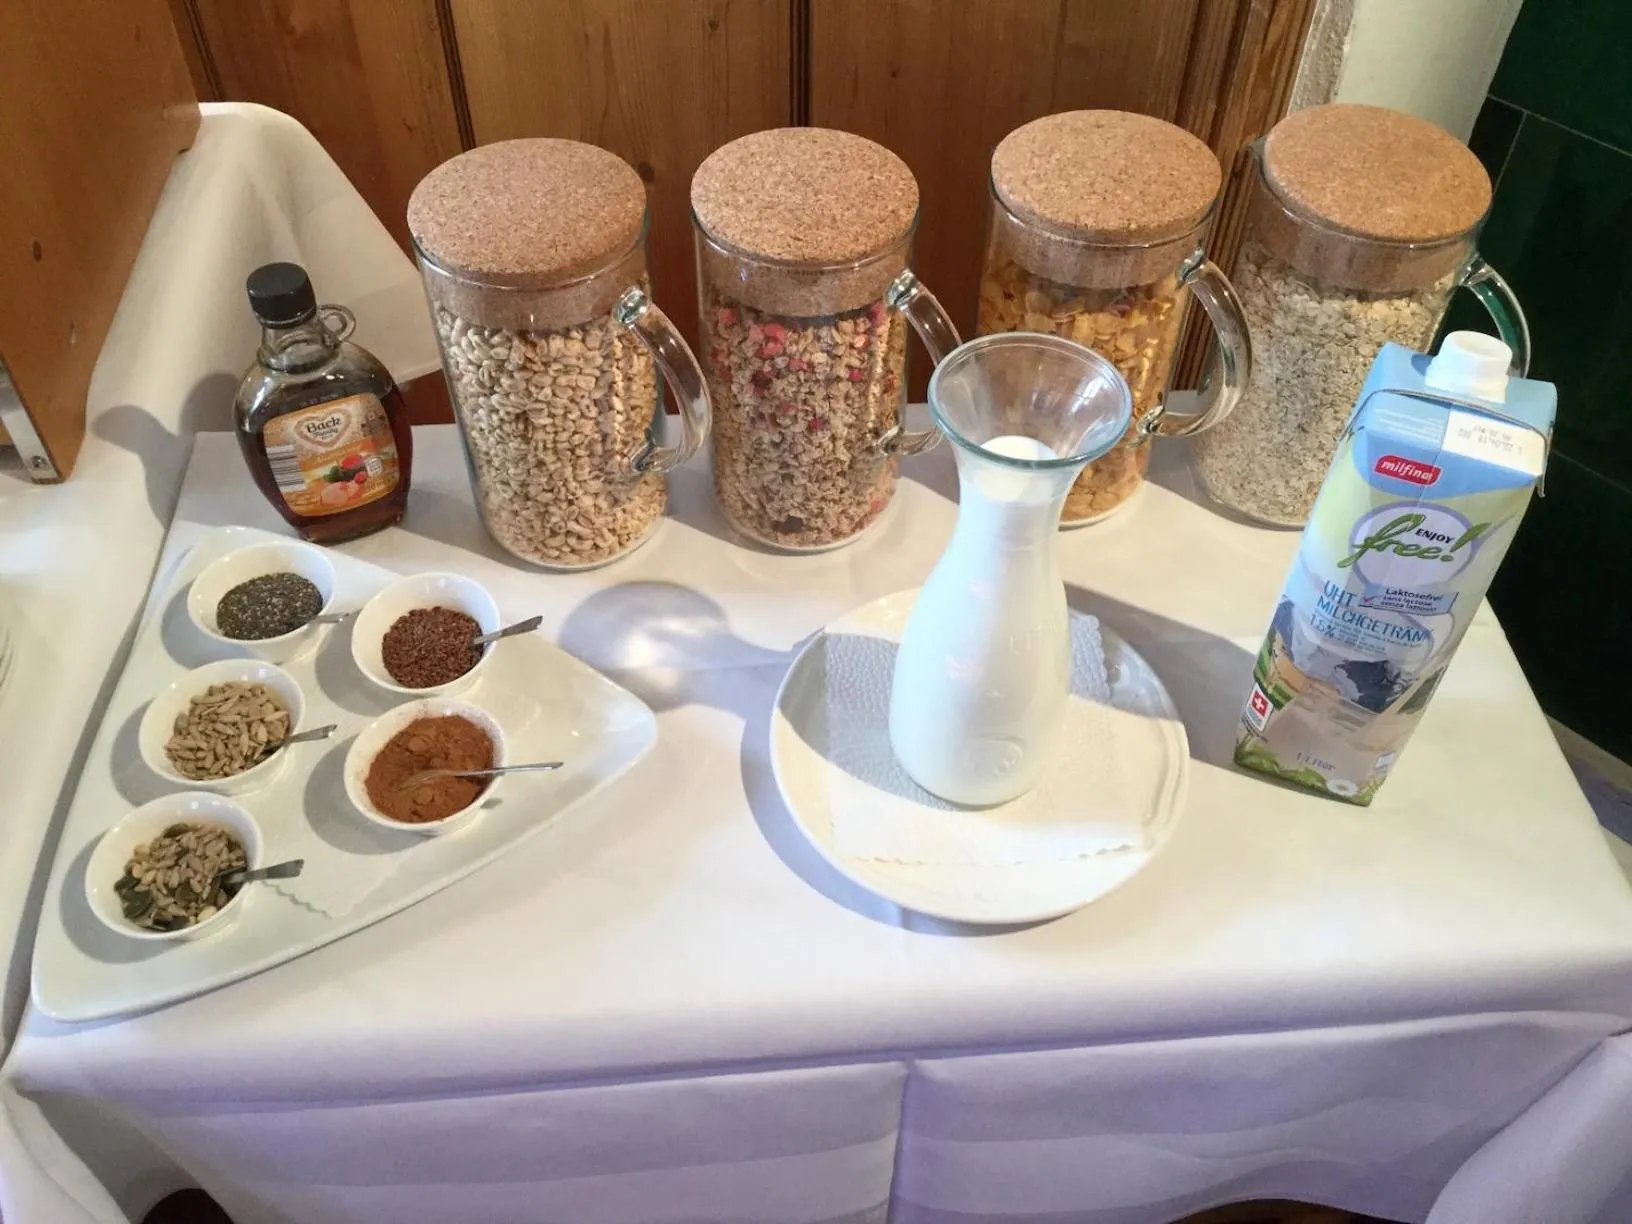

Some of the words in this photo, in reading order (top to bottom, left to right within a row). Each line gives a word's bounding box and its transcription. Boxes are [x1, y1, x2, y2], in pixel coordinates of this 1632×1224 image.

[306, 416, 341, 434] Back
[1380, 460, 1434, 481] milfina
[1336, 513, 1491, 569] free!
[1415, 528, 1455, 544] ENJOY
[1323, 580, 1358, 608] UHT
